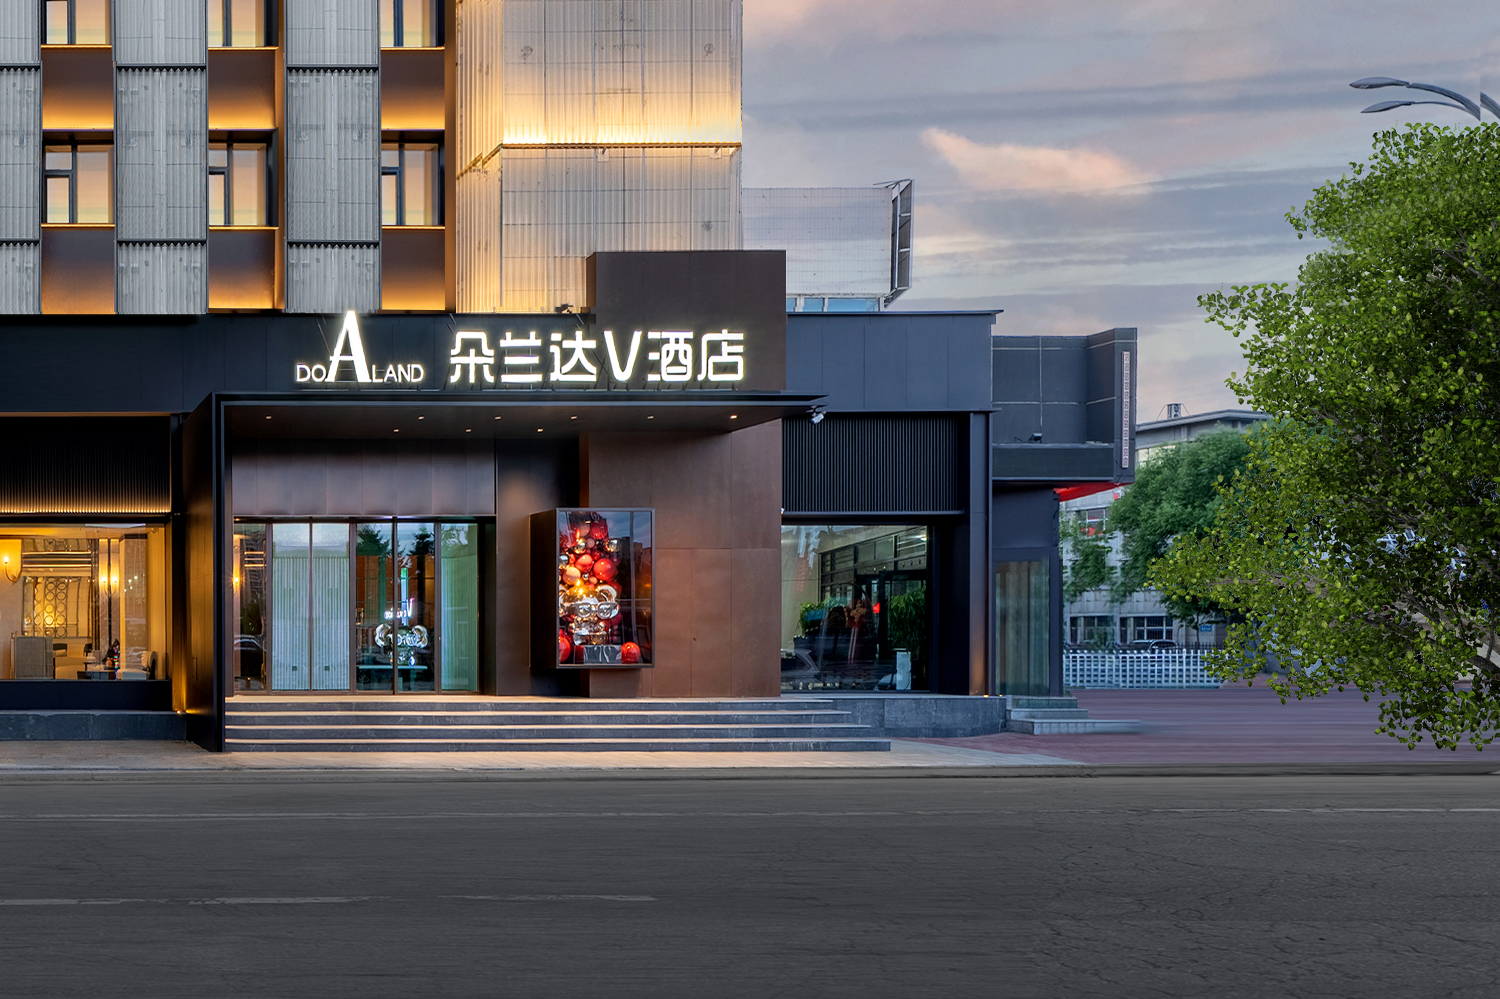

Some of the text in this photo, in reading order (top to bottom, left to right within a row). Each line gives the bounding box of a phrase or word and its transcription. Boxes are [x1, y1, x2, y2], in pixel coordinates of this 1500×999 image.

[449, 329, 745, 384] 朵兰达V酒店
